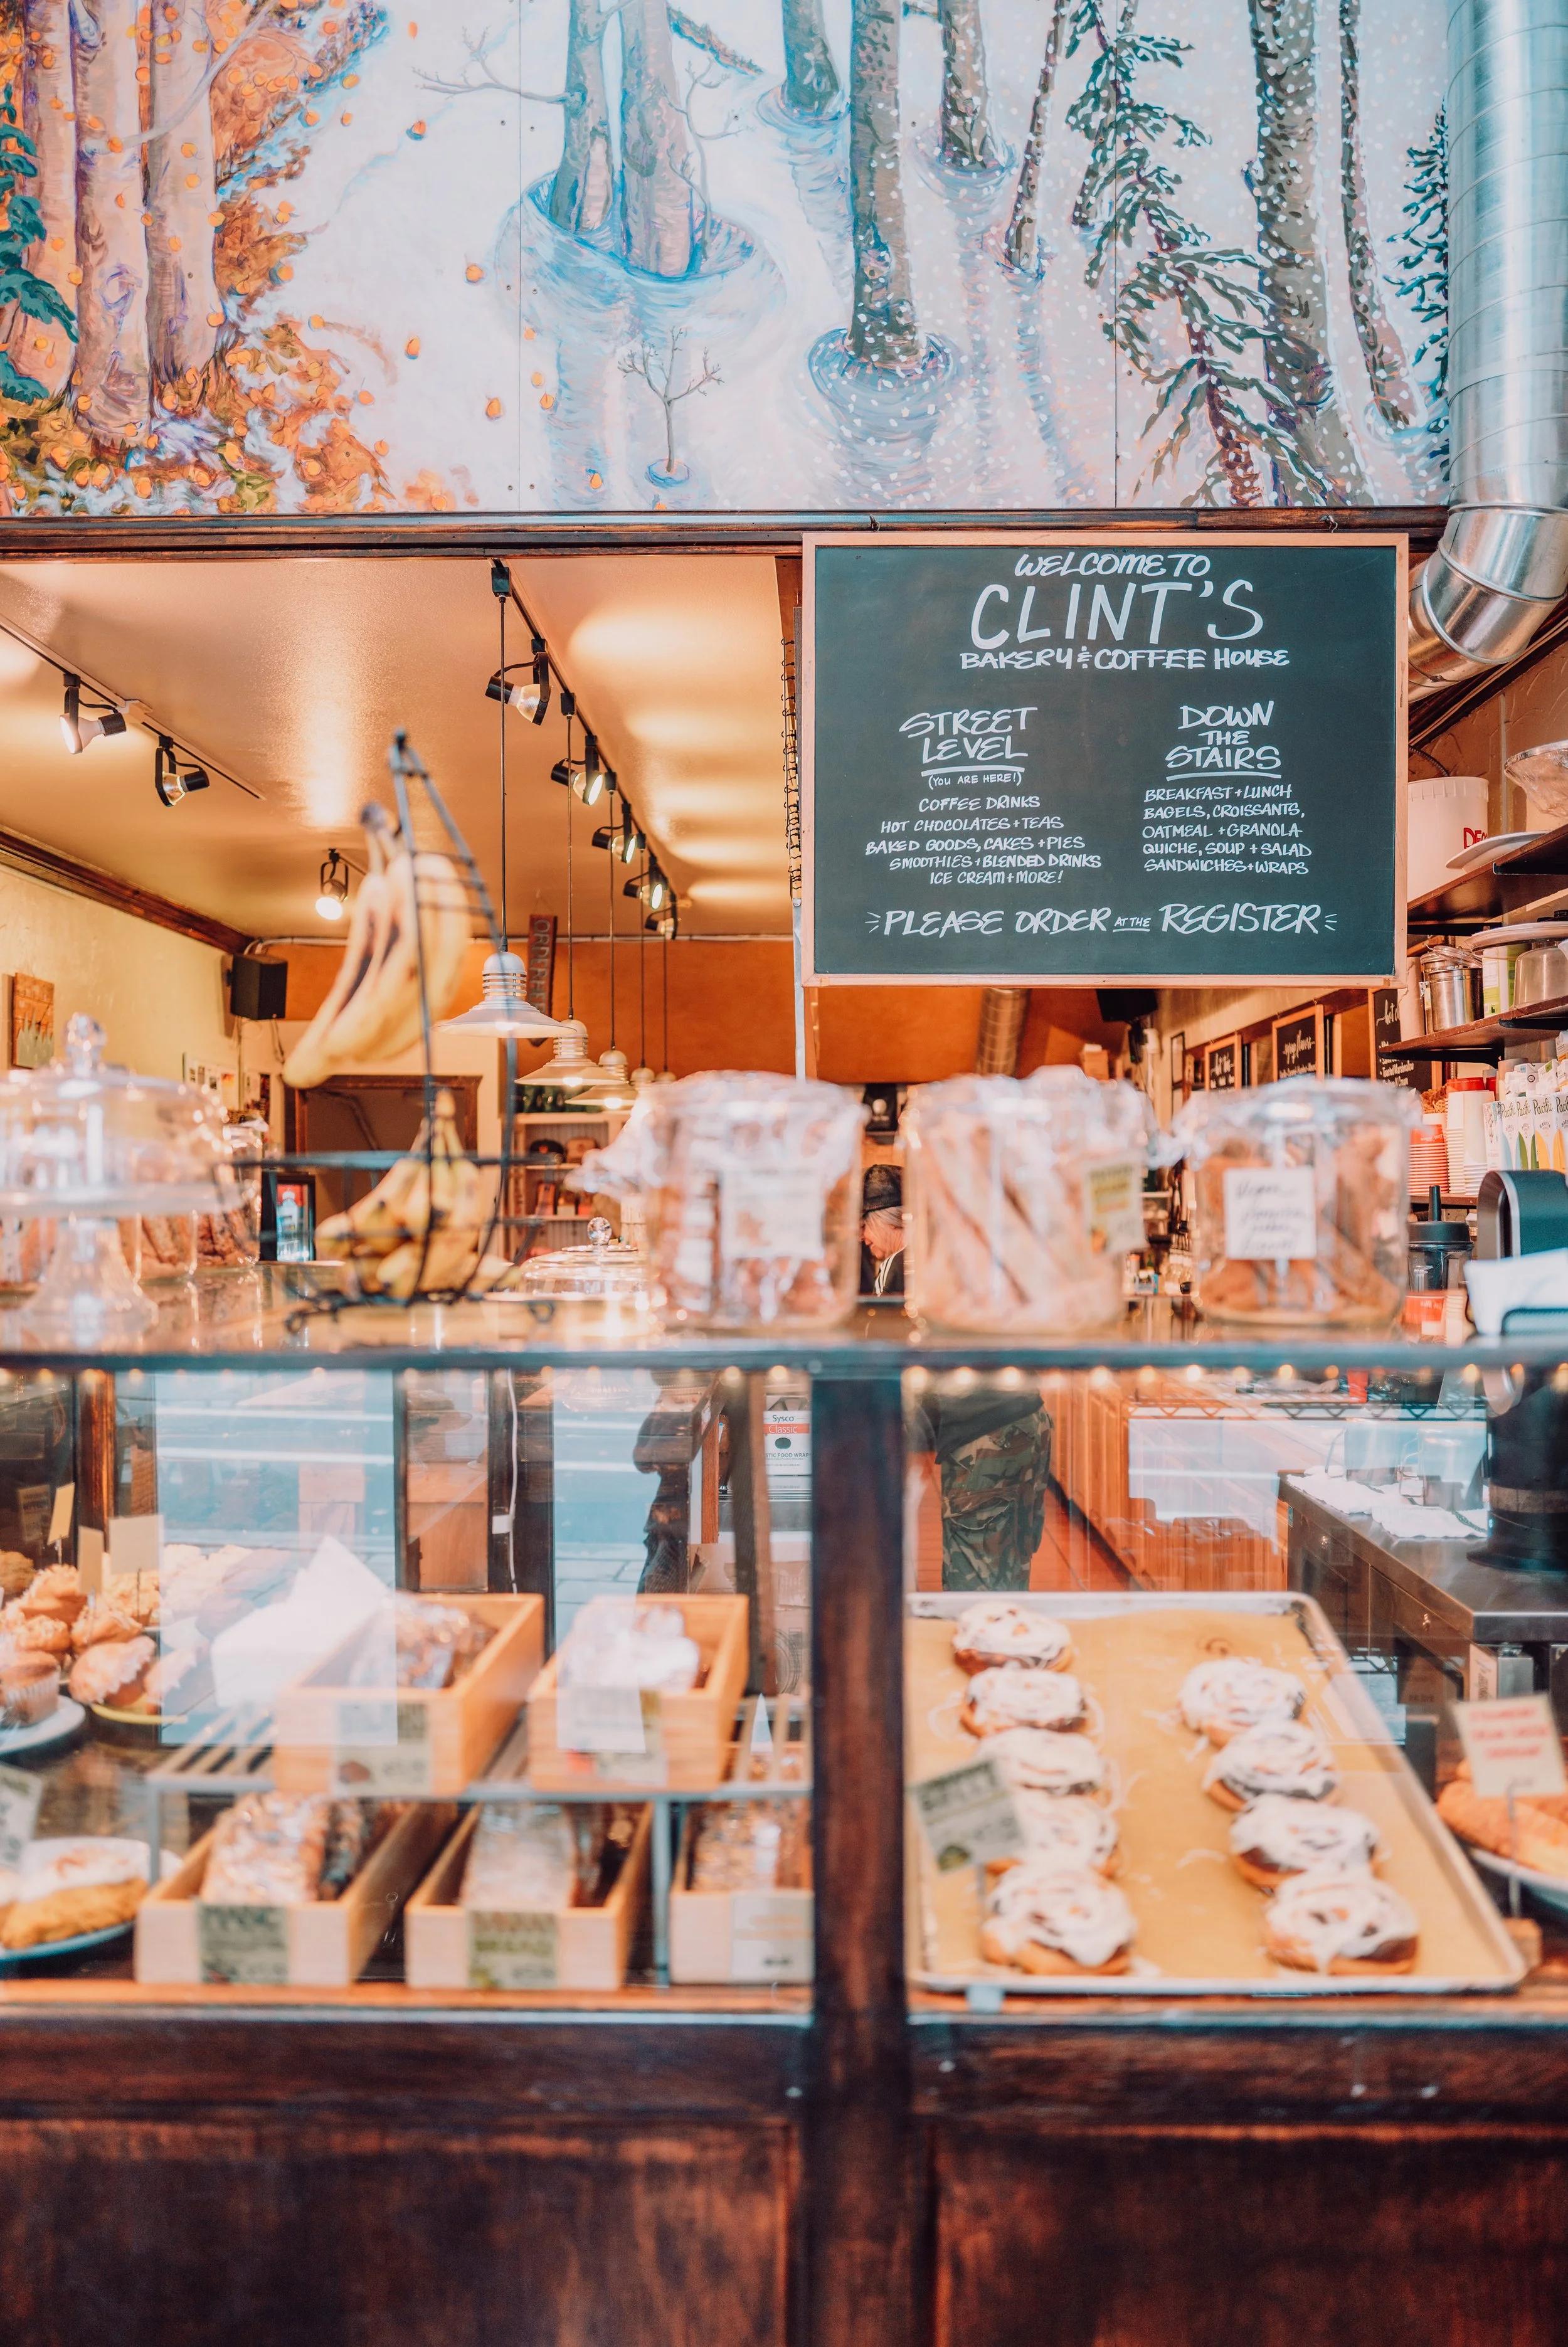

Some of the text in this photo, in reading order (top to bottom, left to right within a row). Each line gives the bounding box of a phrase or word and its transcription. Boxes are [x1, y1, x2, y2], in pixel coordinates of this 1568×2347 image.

[1015, 552, 1210, 576] WELCOME TO
[971, 580, 1263, 649] CLINT'S
[961, 650, 1072, 670] BAKERY
[1094, 649, 1206, 670] COFFEE
[1214, 648, 1290, 669] HOUSE
[899, 707, 1037, 738] STREET
[1178, 701, 1274, 729] DOWN
[1199, 731, 1249, 745] THE
[923, 736, 1028, 763] LEVEL
[1165, 746, 1281, 769] STAIRS
[929, 772, 1022, 790] (YOU ARE HERE!)
[1144, 787, 1233, 802] BREAKFAST
[1244, 784, 1292, 798] LUNCH
[919, 795, 1040, 812] COFFEE DRINKS
[1143, 803, 1305, 819] BAGELS, CROISSANTS,
[881, 821, 909, 833] HOT
[914, 818, 1010, 831] CHOCOLATES
[1022, 816, 1064, 829] TEAS
[1143, 825, 1212, 839] OATMEAL
[1227, 823, 1303, 837] GRANOLA
[866, 840, 919, 855] BAKED
[926, 838, 981, 852] GOODS,
[984, 837, 1034, 850] CAKES
[1047, 837, 1085, 849] PIES
[1143, 843, 1202, 856] QUICHE,
[1205, 843, 1245, 854] SOUP
[1261, 843, 1311, 857] SALAD
[890, 855, 972, 870] SMOOTHIES
[983, 854, 1045, 867] BLENDED
[1049, 854, 1101, 867] DRINKS
[1144, 859, 1247, 872] SANDWICHES
[1256, 861, 1308, 874] WRAPS
[931, 872, 952, 884] ICE
[958, 871, 1004, 884] CREAM
[1017, 871, 1063, 883] MORE!
[884, 903, 1321, 938] PLEASE ORDER AT THE REGISTER
[1532, 1098, 1553, 1115] Pacific
[1555, 1096, 1568, 1113] Pacif
[772, 1414, 794, 1423] Sysco
[769, 1424, 798, 1434] Classic
